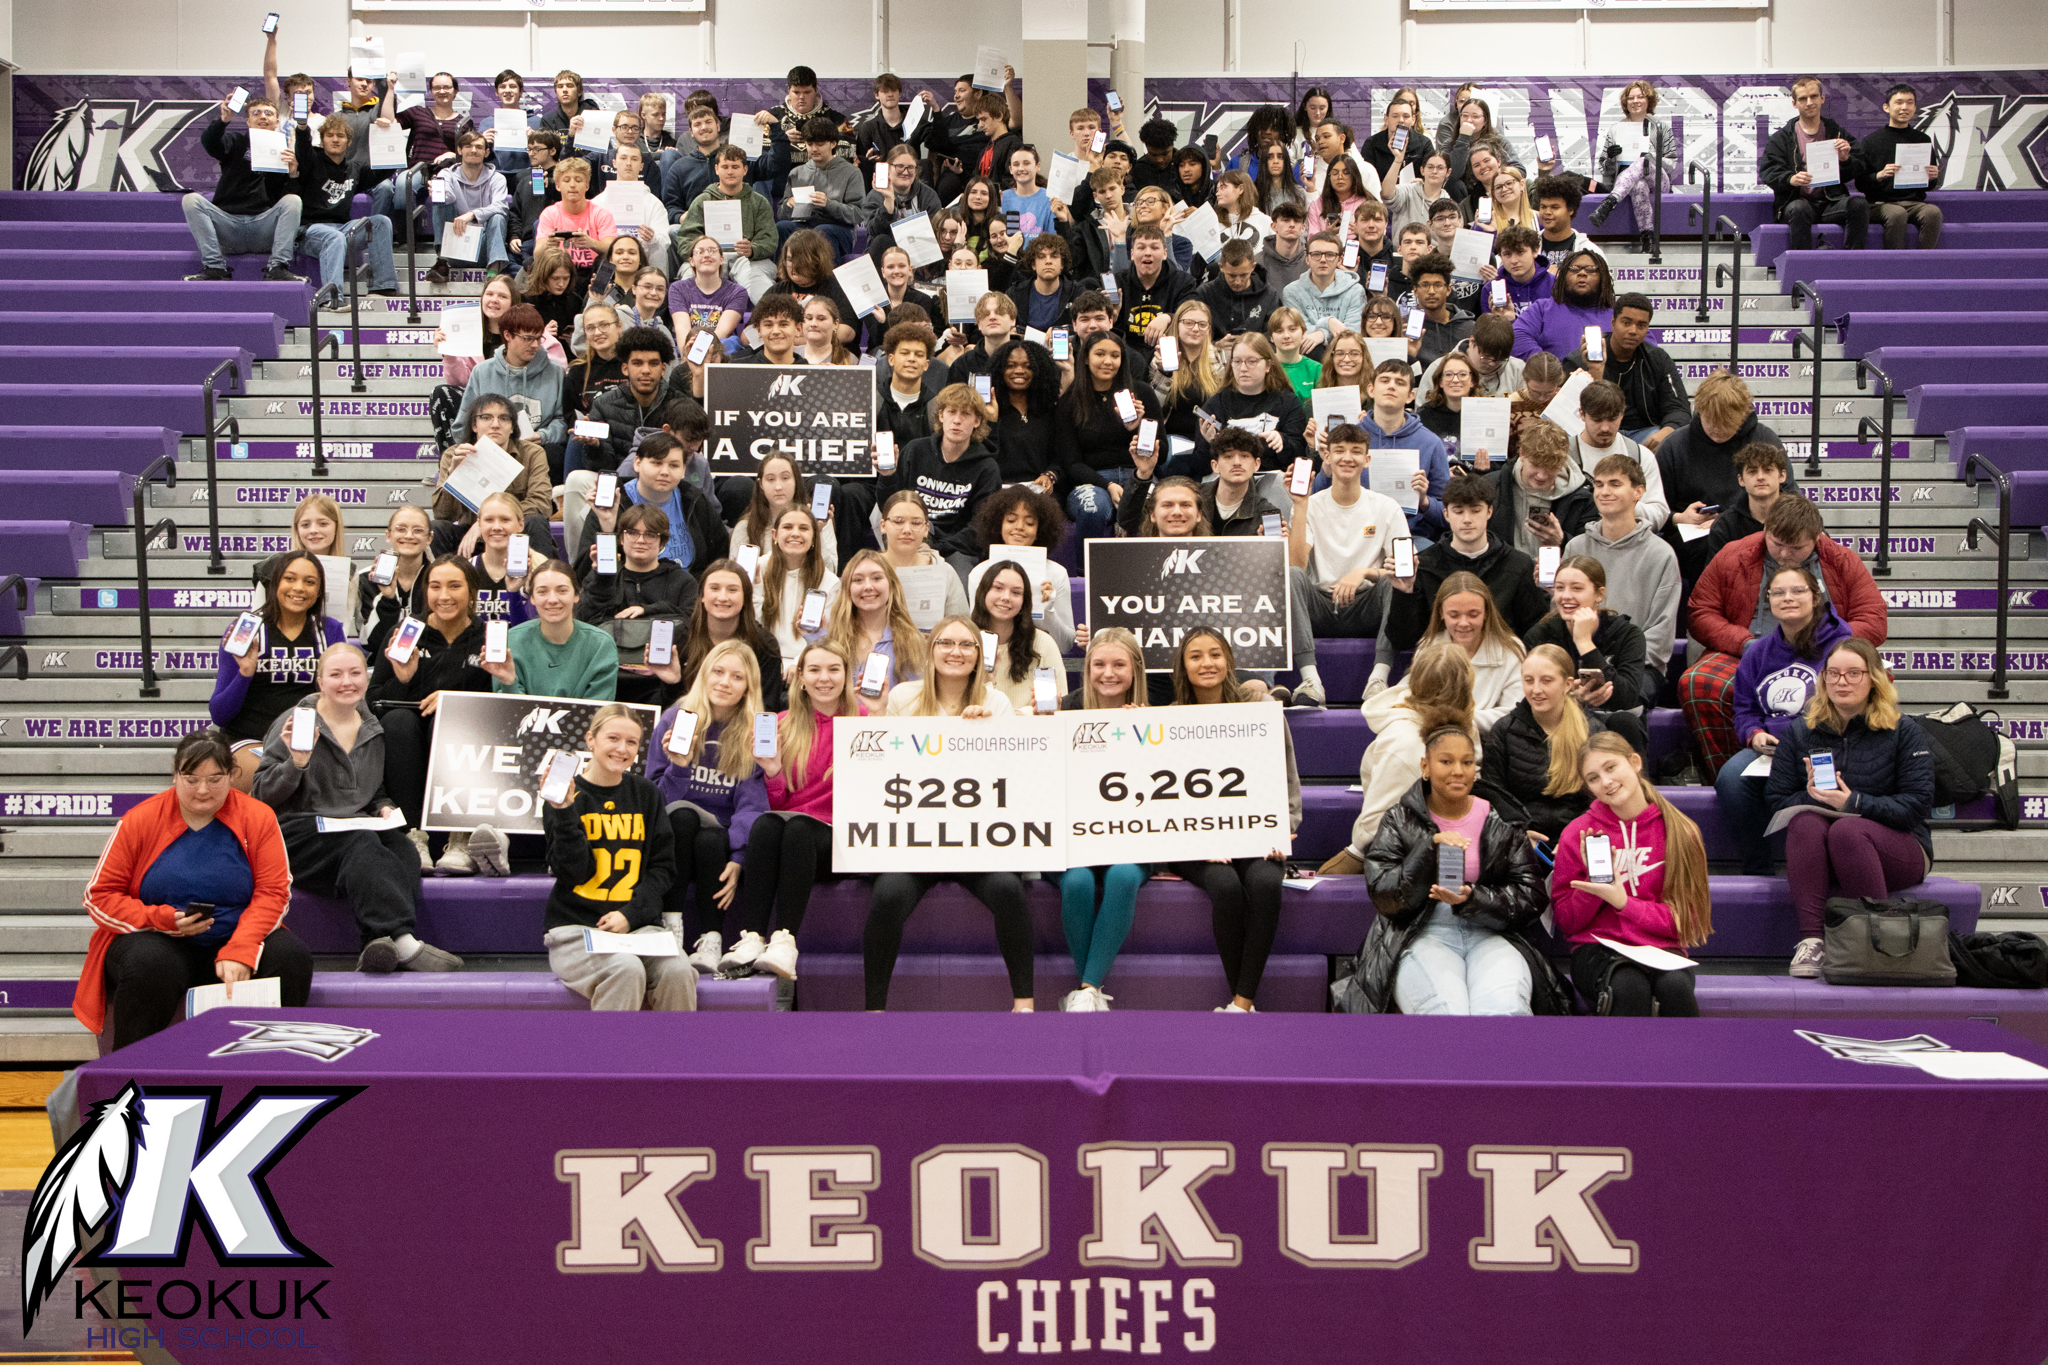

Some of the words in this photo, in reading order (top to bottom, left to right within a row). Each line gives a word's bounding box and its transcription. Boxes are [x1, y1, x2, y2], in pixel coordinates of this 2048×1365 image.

[1616, 268, 1645, 281] ARE
[386, 299, 409, 312] WE
[1661, 329, 1731, 344] #KPRIDE
[329, 401, 362, 416] ARE
[714, 410, 740, 427] IF
[747, 410, 802, 428] YOU
[811, 411, 867, 428] ARE
[711, 437, 739, 460] A
[749, 438, 869, 462] CHIEF
[236, 487, 292, 503] CHIEF
[916, 475, 972, 495] ONWARD
[218, 536, 258, 553] ARE
[1100, 595, 1165, 615] YOU
[1176, 594, 1243, 614] ARE
[1253, 594, 1276, 613] A
[1912, 652, 1955, 671] ARE
[24, 718, 63, 738] WE
[67, 718, 113, 738] ARE
[1132, 723, 1164, 746] VU
[911, 734, 943, 756] VU
[445, 743, 523, 774] WE
[883, 773, 1008, 814] $281
[1099, 766, 1248, 808] 6,262
[4, 794, 113, 816] #KPRIDE
[847, 821, 1053, 848] MILLION
[1072, 814, 1279, 837] SCHOLARSHIPS
[555, 1142, 1640, 1274] KEOKUK
[975, 1277, 1218, 1355] CHIEFS
